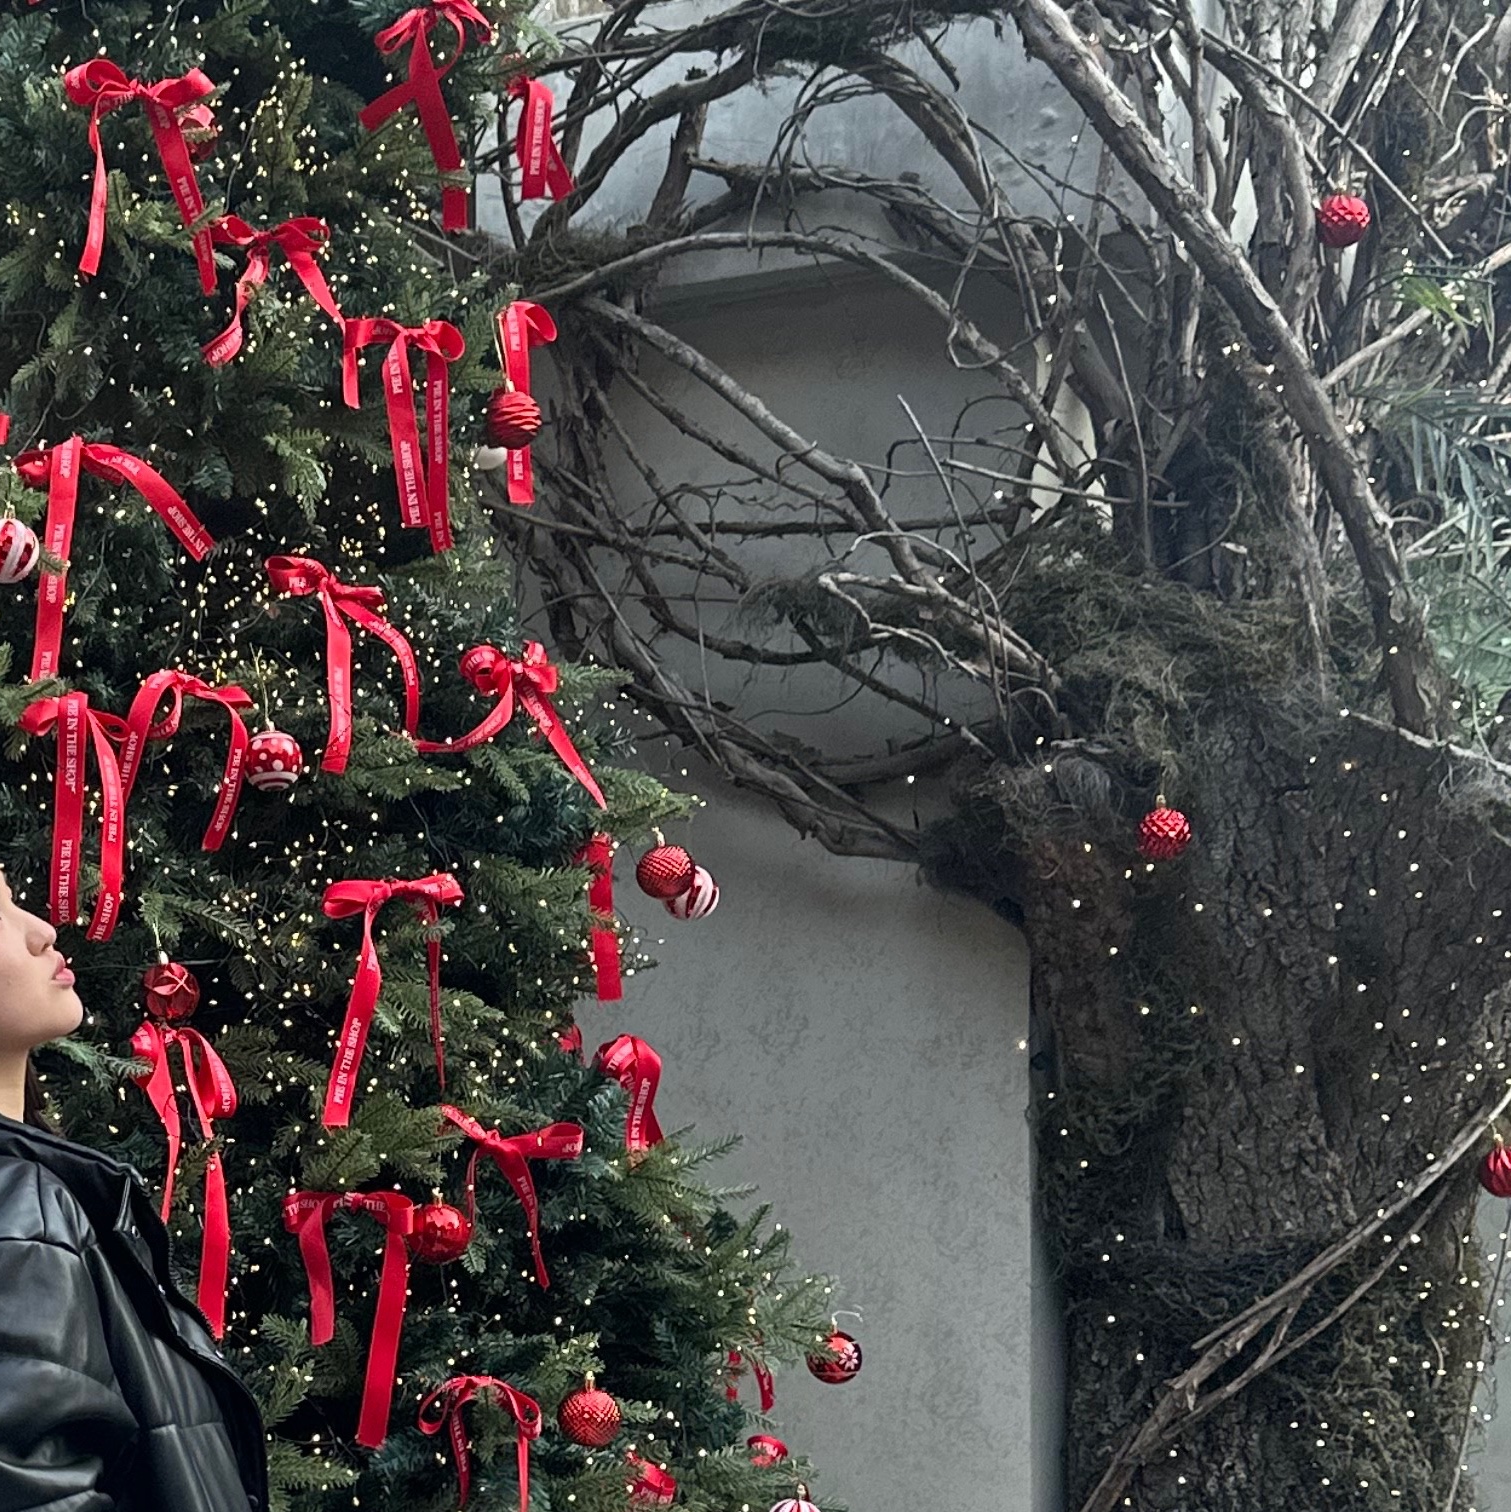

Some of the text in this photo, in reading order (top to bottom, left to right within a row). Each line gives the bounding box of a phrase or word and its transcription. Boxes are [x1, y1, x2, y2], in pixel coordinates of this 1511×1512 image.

[176, 176, 196, 209] PIE IN
[389, 360, 403, 393] PIE IN
[433, 380, 442, 463] PIE IN THE SHOP
[513, 449, 522, 479] PIE IN
[399, 440, 421, 524] PIE IN THE SHOP
[166, 503, 187, 527] SHOP
[433, 511, 445, 542] PIE IN
[67, 699, 77, 715] PIE
[67, 717, 77, 730] IN
[66, 733, 77, 755] THE
[123, 730, 139, 761] SHOP
[230, 747, 243, 767] PIE
[228, 767, 238, 779] IN
[222, 780, 236, 804] THE
[106, 823, 116, 842] PIE
[56, 839, 71, 921] PIE IN THE SHO
[92, 892, 116, 941] HE SHOP
[332, 1016, 362, 1103] PIE IN THE SHOP
